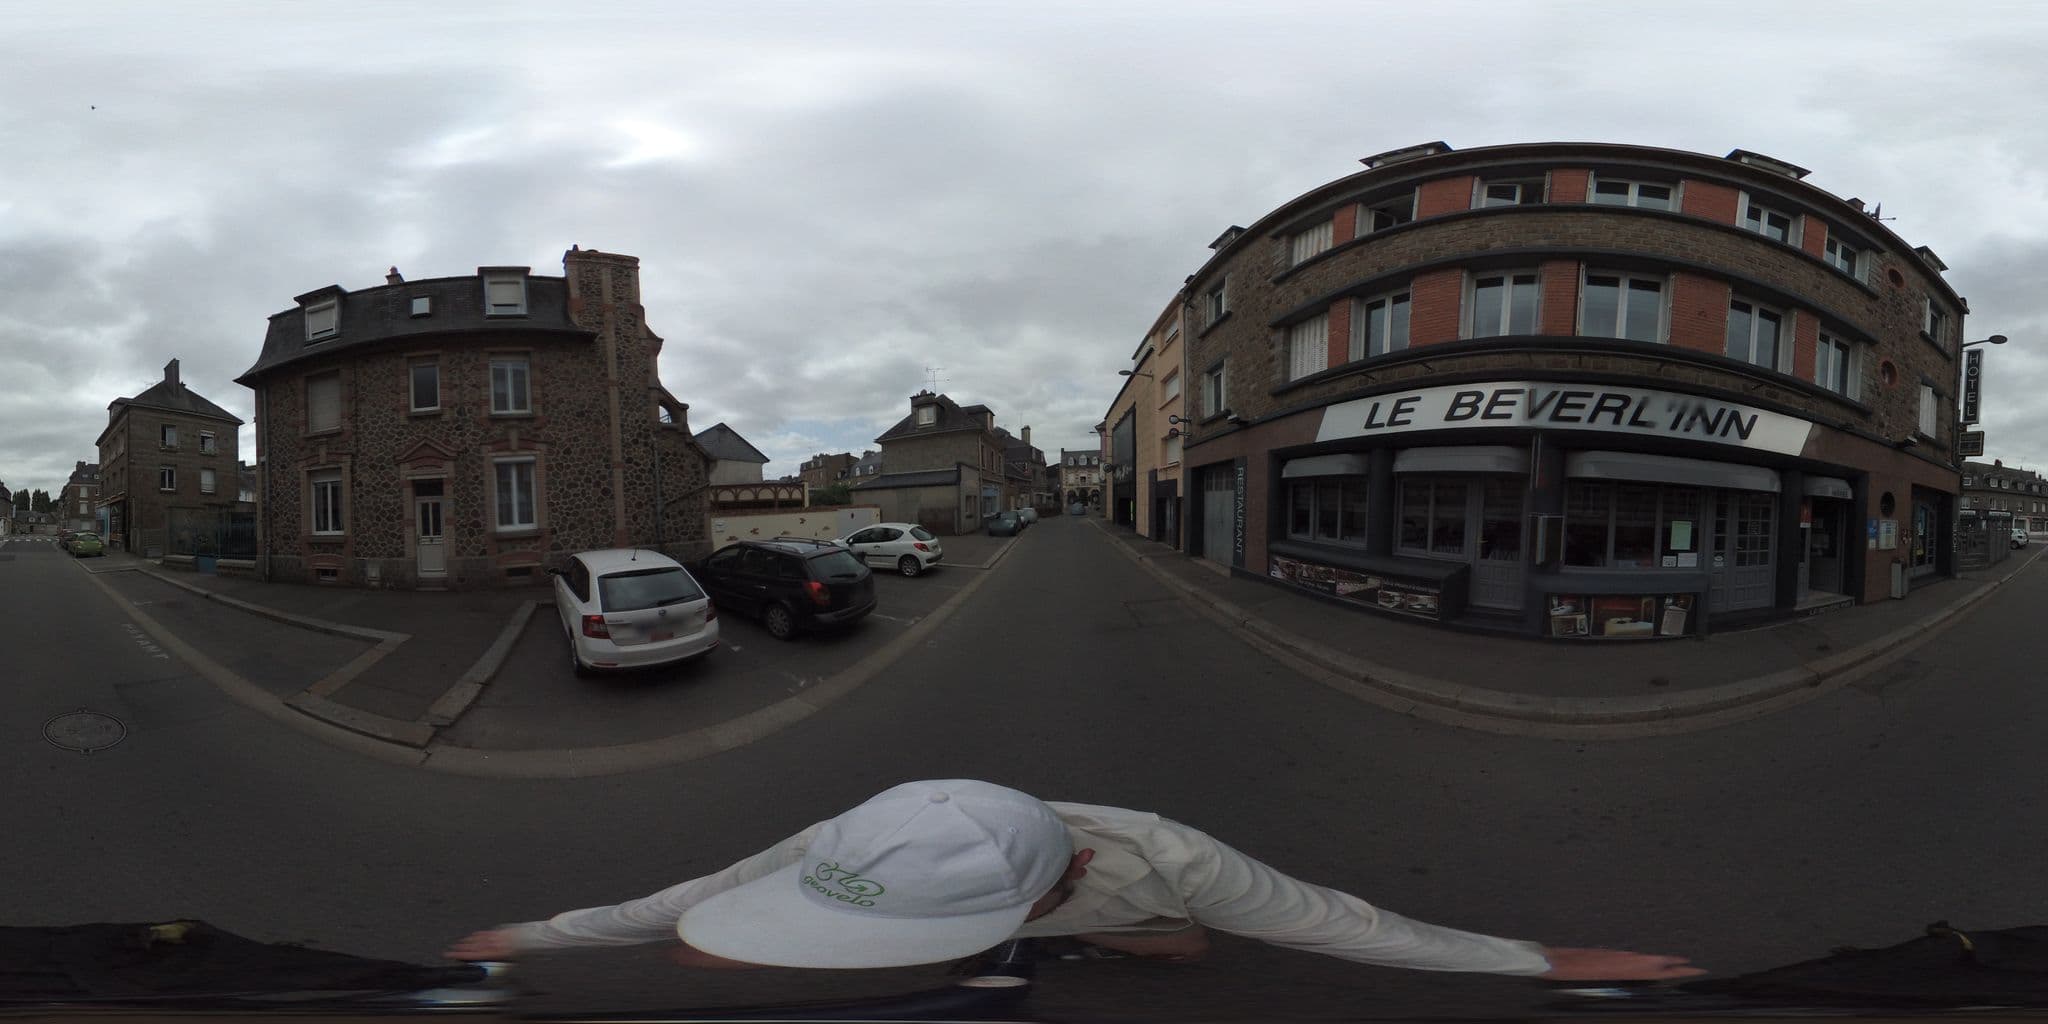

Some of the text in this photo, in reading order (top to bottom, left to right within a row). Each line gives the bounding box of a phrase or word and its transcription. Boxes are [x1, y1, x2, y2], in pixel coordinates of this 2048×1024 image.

[1967, 355, 1979, 417] HOTEL
[1364, 396, 1422, 429] LE
[1236, 465, 1245, 555] RESTAURANT
[801, 875, 876, 907] geovelo
